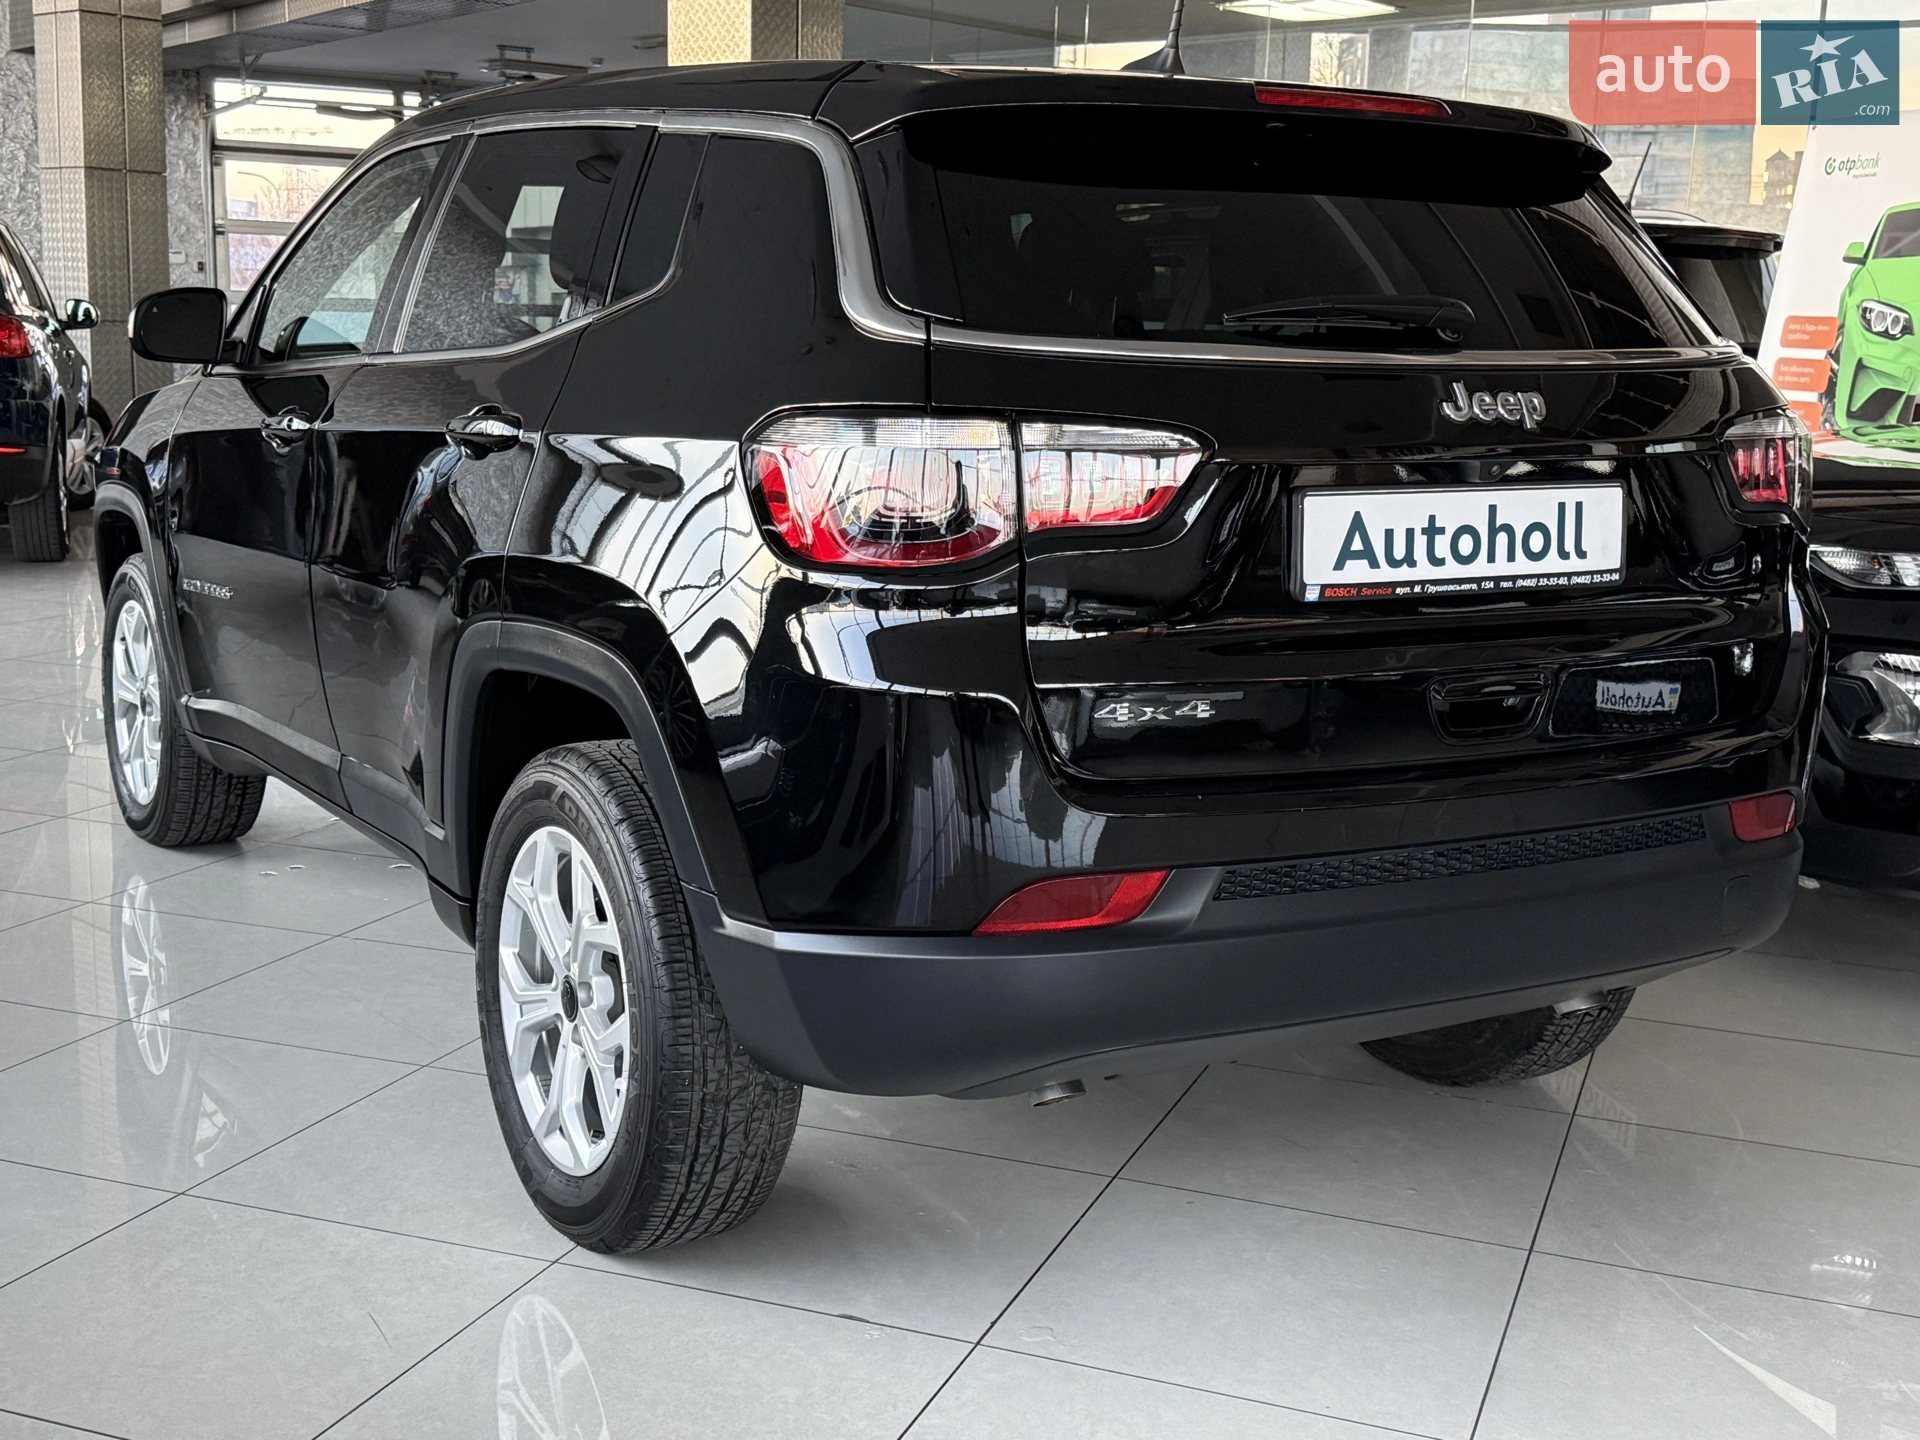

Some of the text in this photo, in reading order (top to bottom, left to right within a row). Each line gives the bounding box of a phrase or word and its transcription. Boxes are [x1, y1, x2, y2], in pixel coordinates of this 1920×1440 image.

[1441, 380, 1546, 429] Jeep
[1332, 501, 1588, 571] Autoholl
[1324, 587, 1358, 597] BOSCH
[1360, 586, 1393, 596] Service
